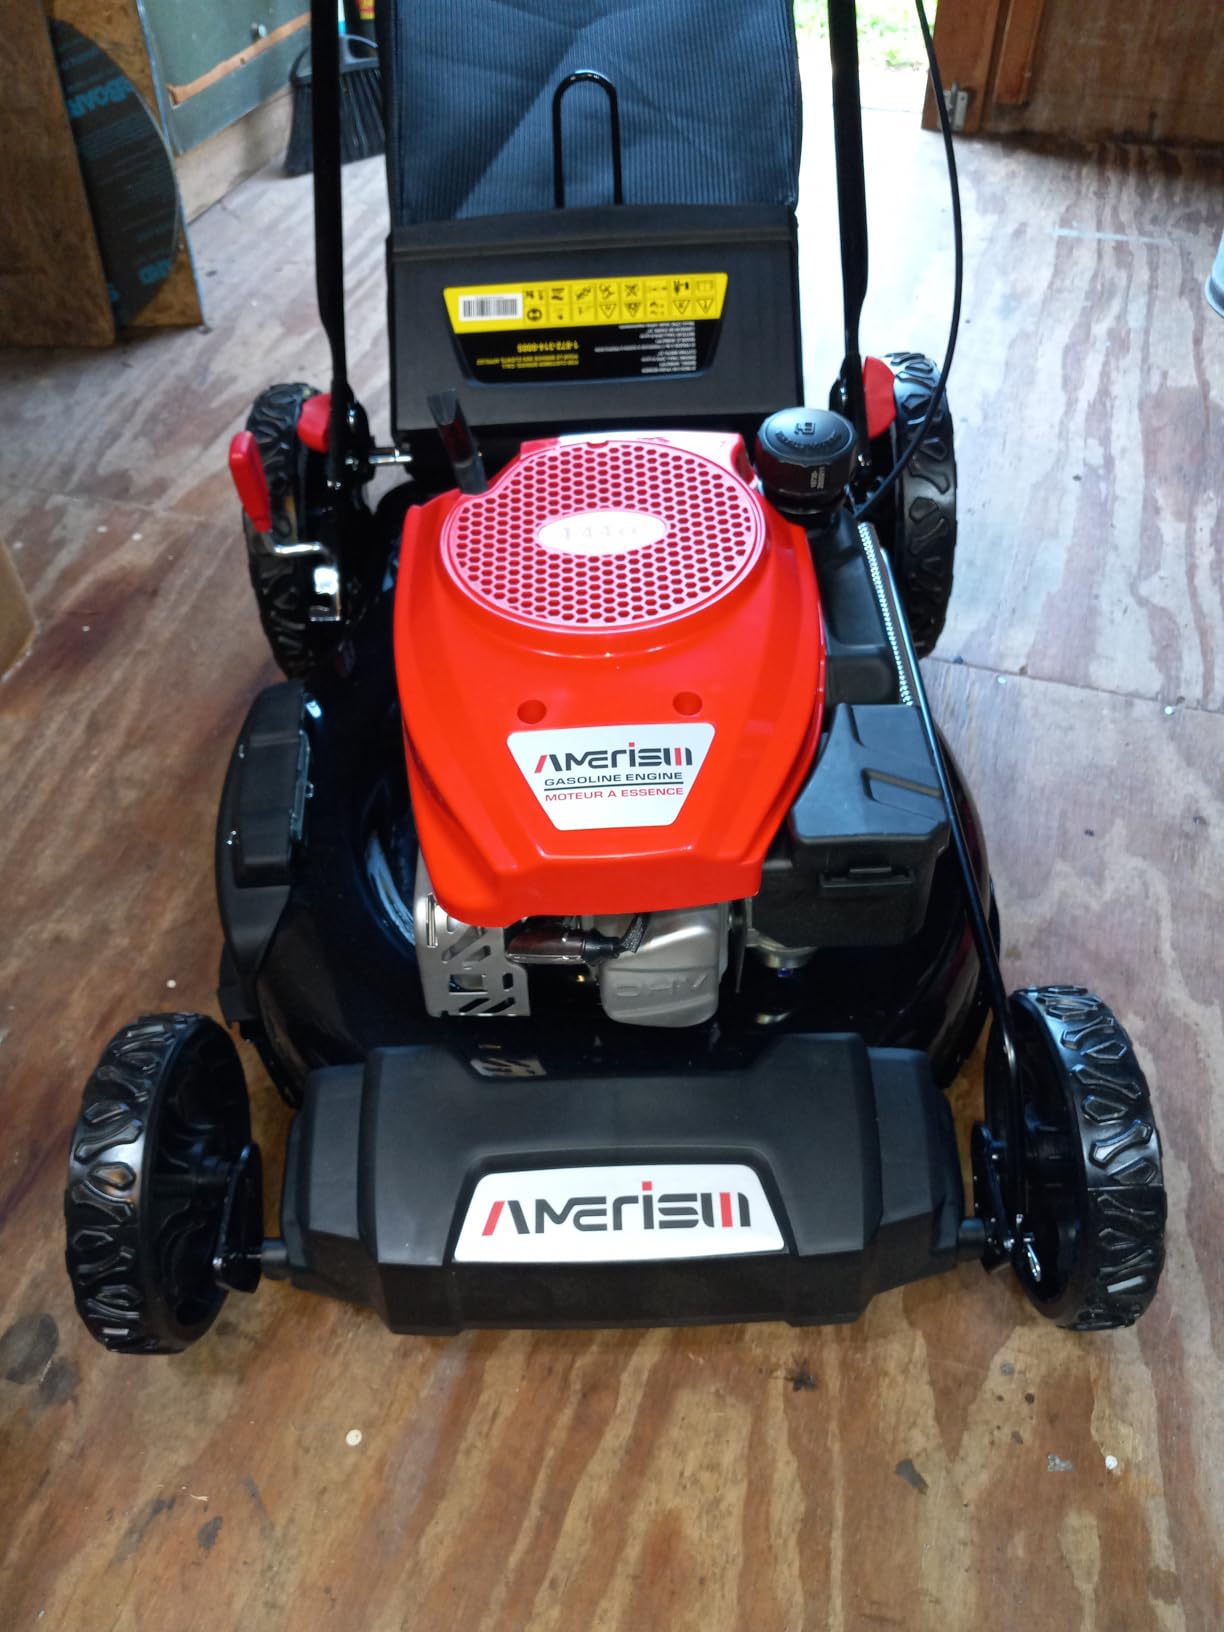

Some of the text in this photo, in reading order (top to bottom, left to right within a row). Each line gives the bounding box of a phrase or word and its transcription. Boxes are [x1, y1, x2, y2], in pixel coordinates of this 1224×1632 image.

[544, 772, 683, 787] GASOLINE ENGINE
[545, 790, 604, 802] MOTEUR
[620, 787, 684, 797] ESSENCE
